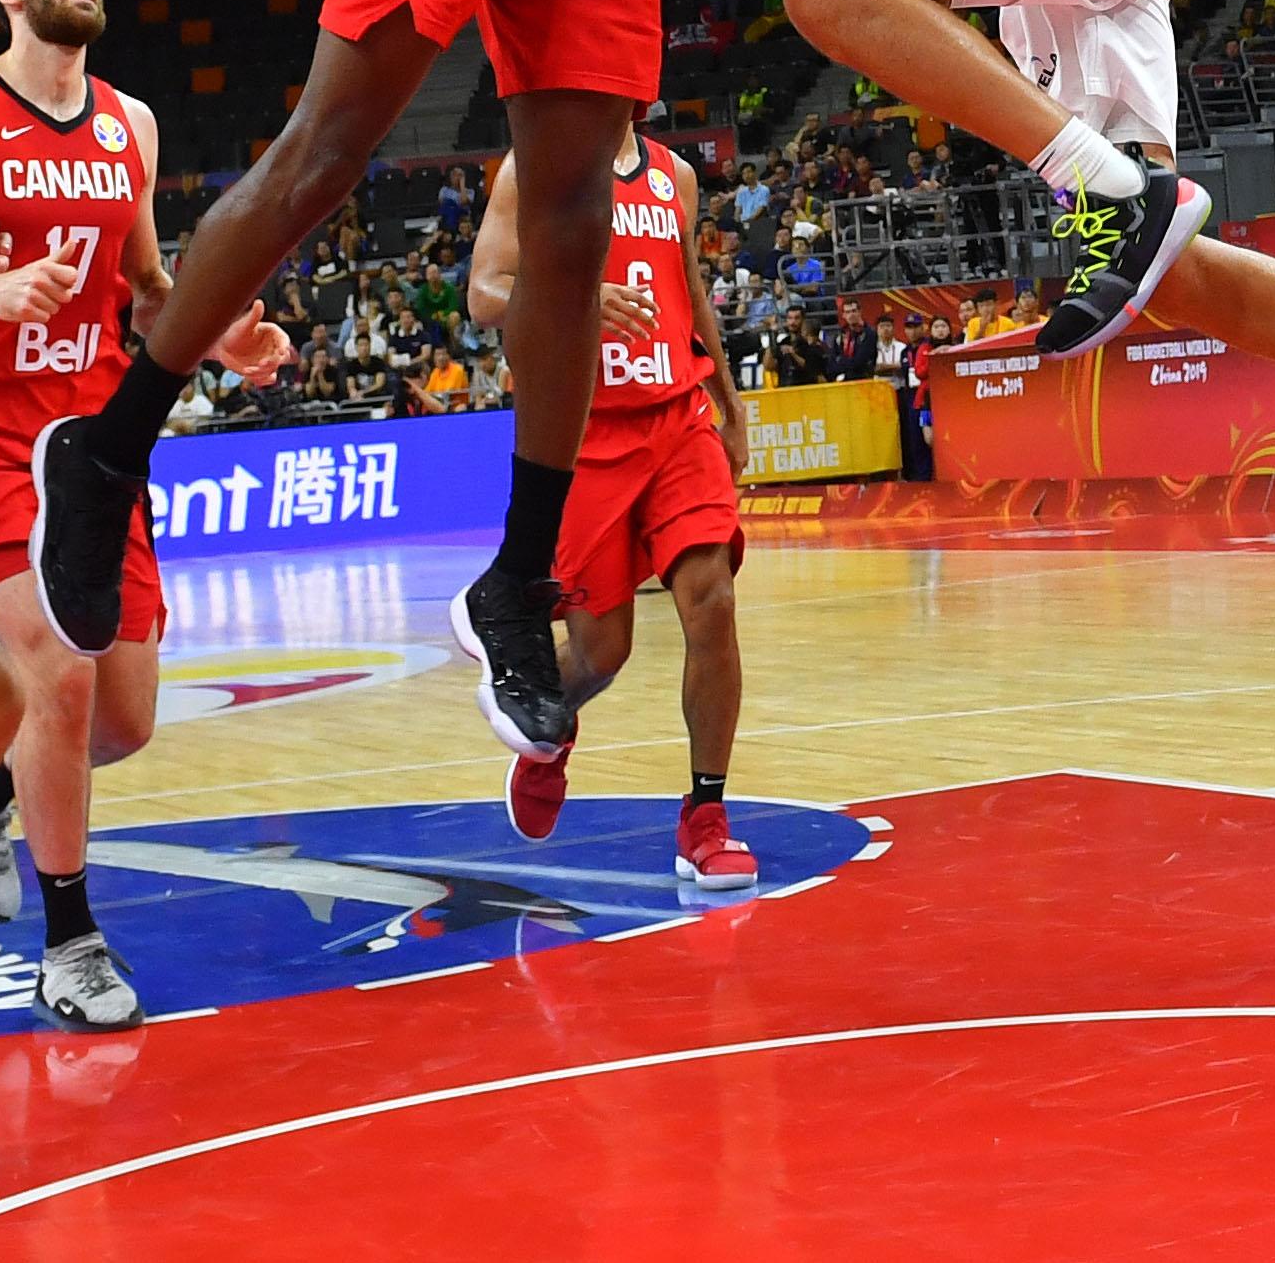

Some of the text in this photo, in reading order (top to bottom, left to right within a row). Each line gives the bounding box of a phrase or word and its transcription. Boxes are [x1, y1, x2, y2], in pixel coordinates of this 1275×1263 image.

[2, 159, 133, 202] CANADA
[15, 321, 102, 373] Bell
[601, 342, 674, 387] Bell
[773, 443, 839, 473] GAME
[268, 442, 400, 530] 腾讯
